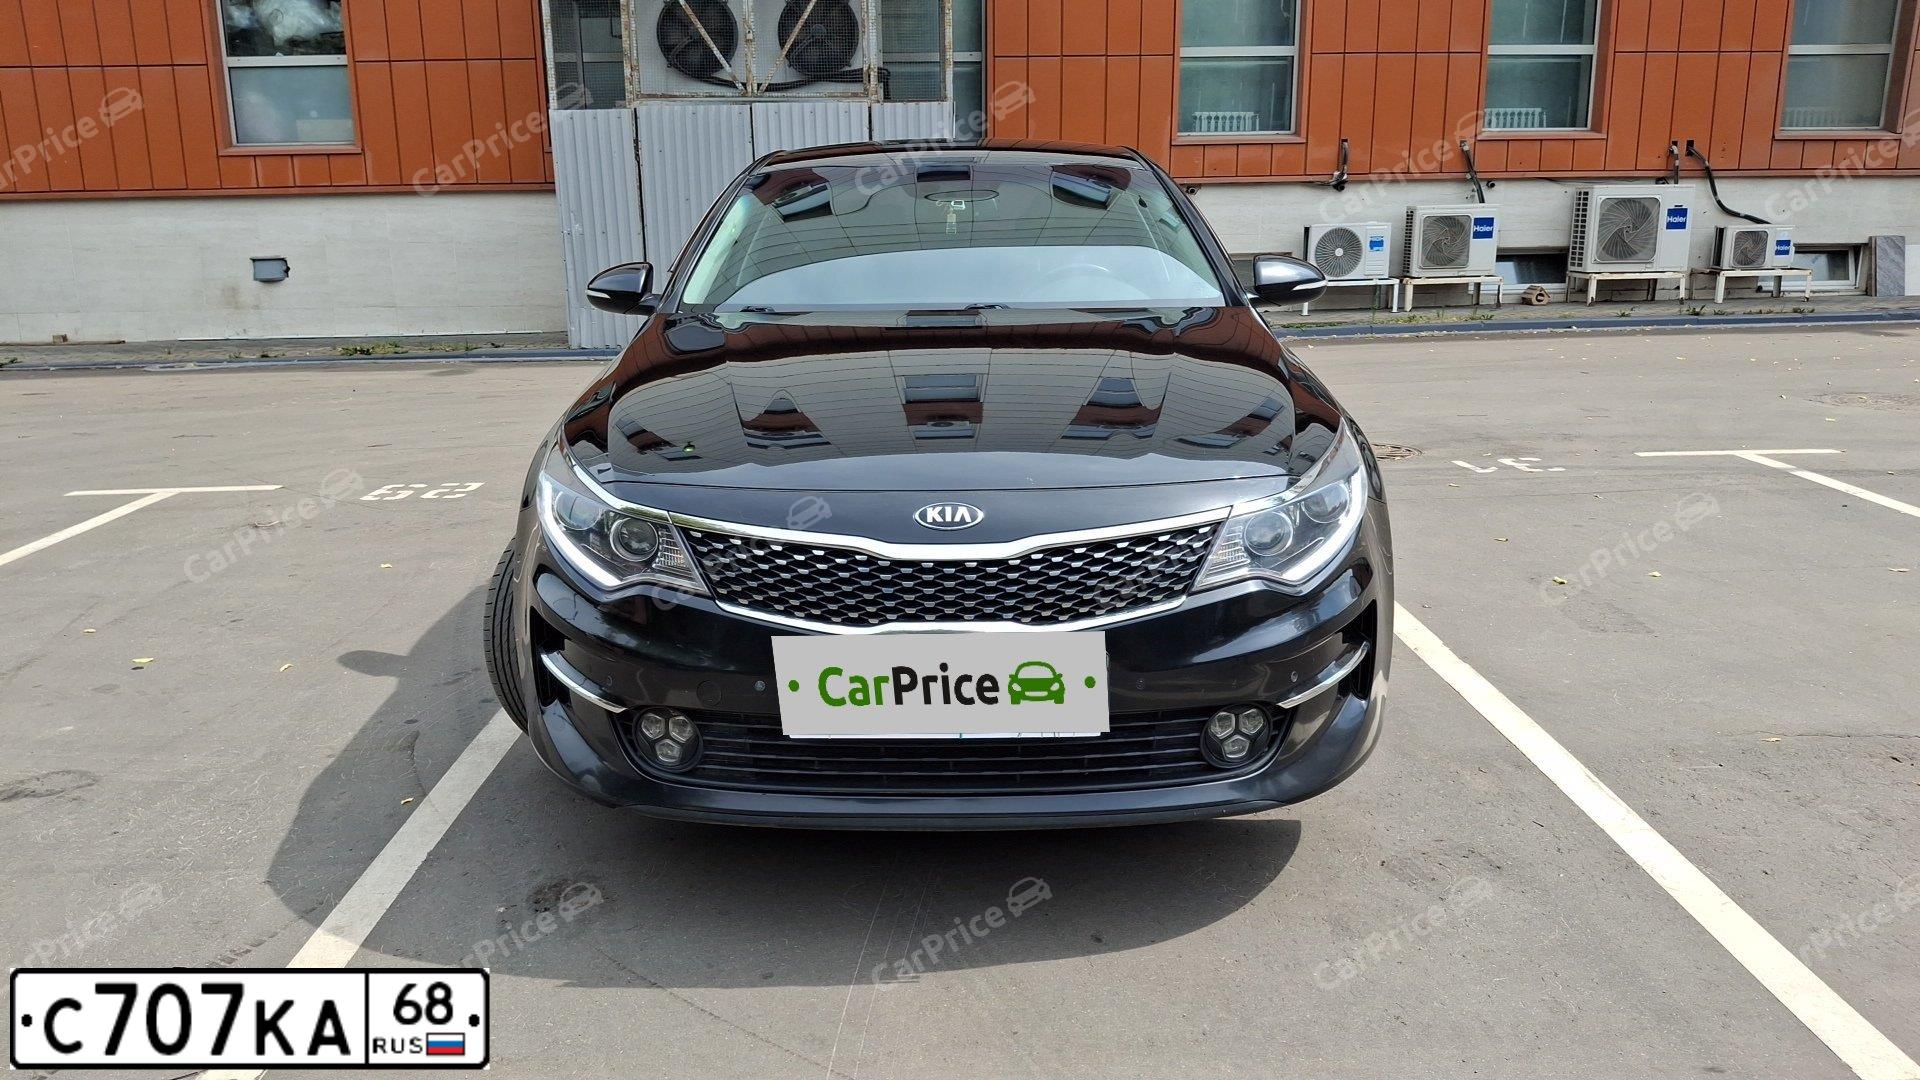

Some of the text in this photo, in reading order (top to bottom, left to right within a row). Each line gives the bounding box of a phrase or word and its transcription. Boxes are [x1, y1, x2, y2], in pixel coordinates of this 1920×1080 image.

[1666, 215, 1687, 223] Haier
[1473, 224, 1494, 233] Haier
[926, 506, 972, 523] KIA
